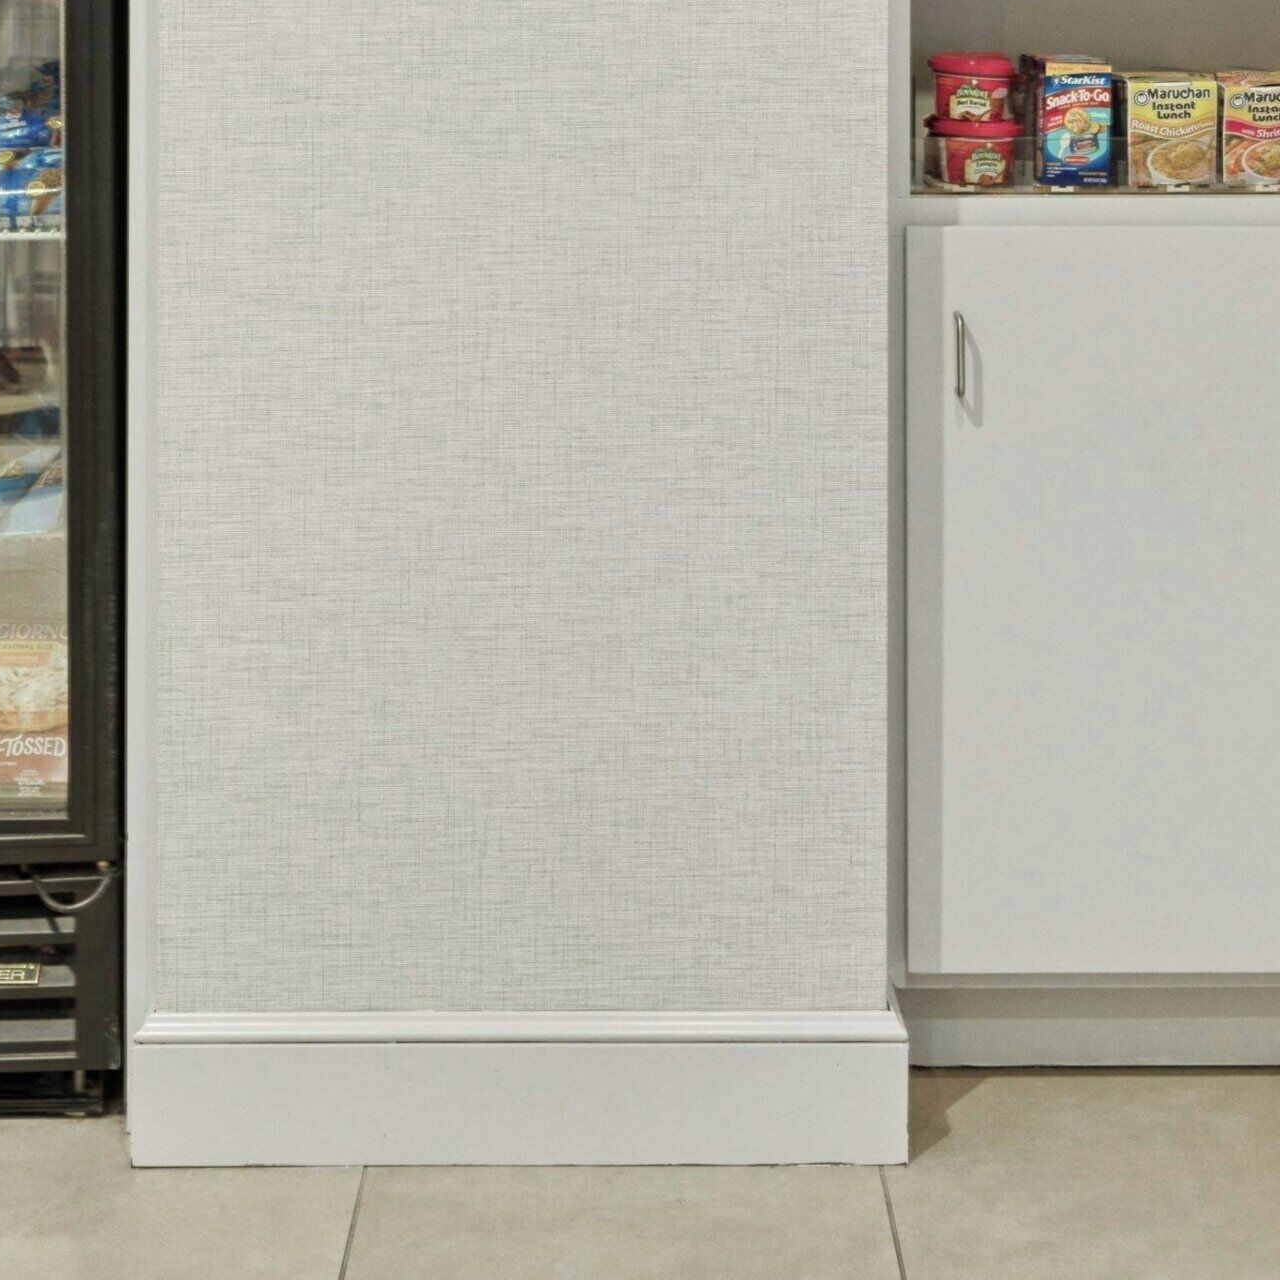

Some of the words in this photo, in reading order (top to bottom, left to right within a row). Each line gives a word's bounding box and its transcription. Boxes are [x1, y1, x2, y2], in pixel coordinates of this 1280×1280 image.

[1060, 75, 1106, 86] StarKist
[1147, 87, 1211, 100] Maruchan
[1151, 102, 1196, 111] Instant
[1157, 110, 1191, 119] Lunch
[1132, 120, 1159, 134] Roast
[1159, 124, 1197, 136] Chicken
